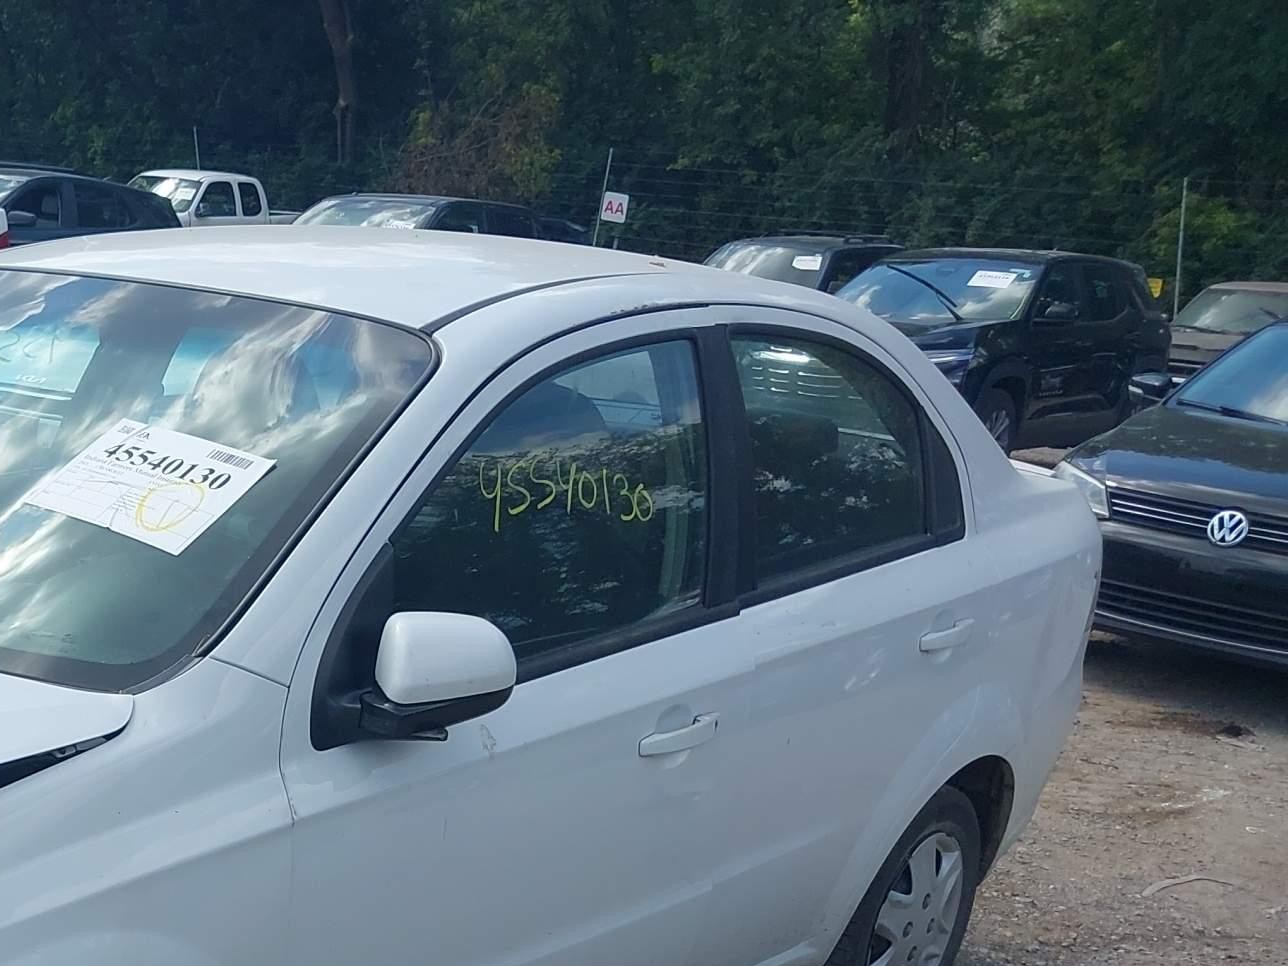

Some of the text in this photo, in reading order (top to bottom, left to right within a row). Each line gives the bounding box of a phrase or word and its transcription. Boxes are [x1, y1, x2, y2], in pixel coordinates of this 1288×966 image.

[604, 200, 624, 216] AA
[103, 443, 232, 490] 45540130
[479, 455, 653, 532] 45540130
